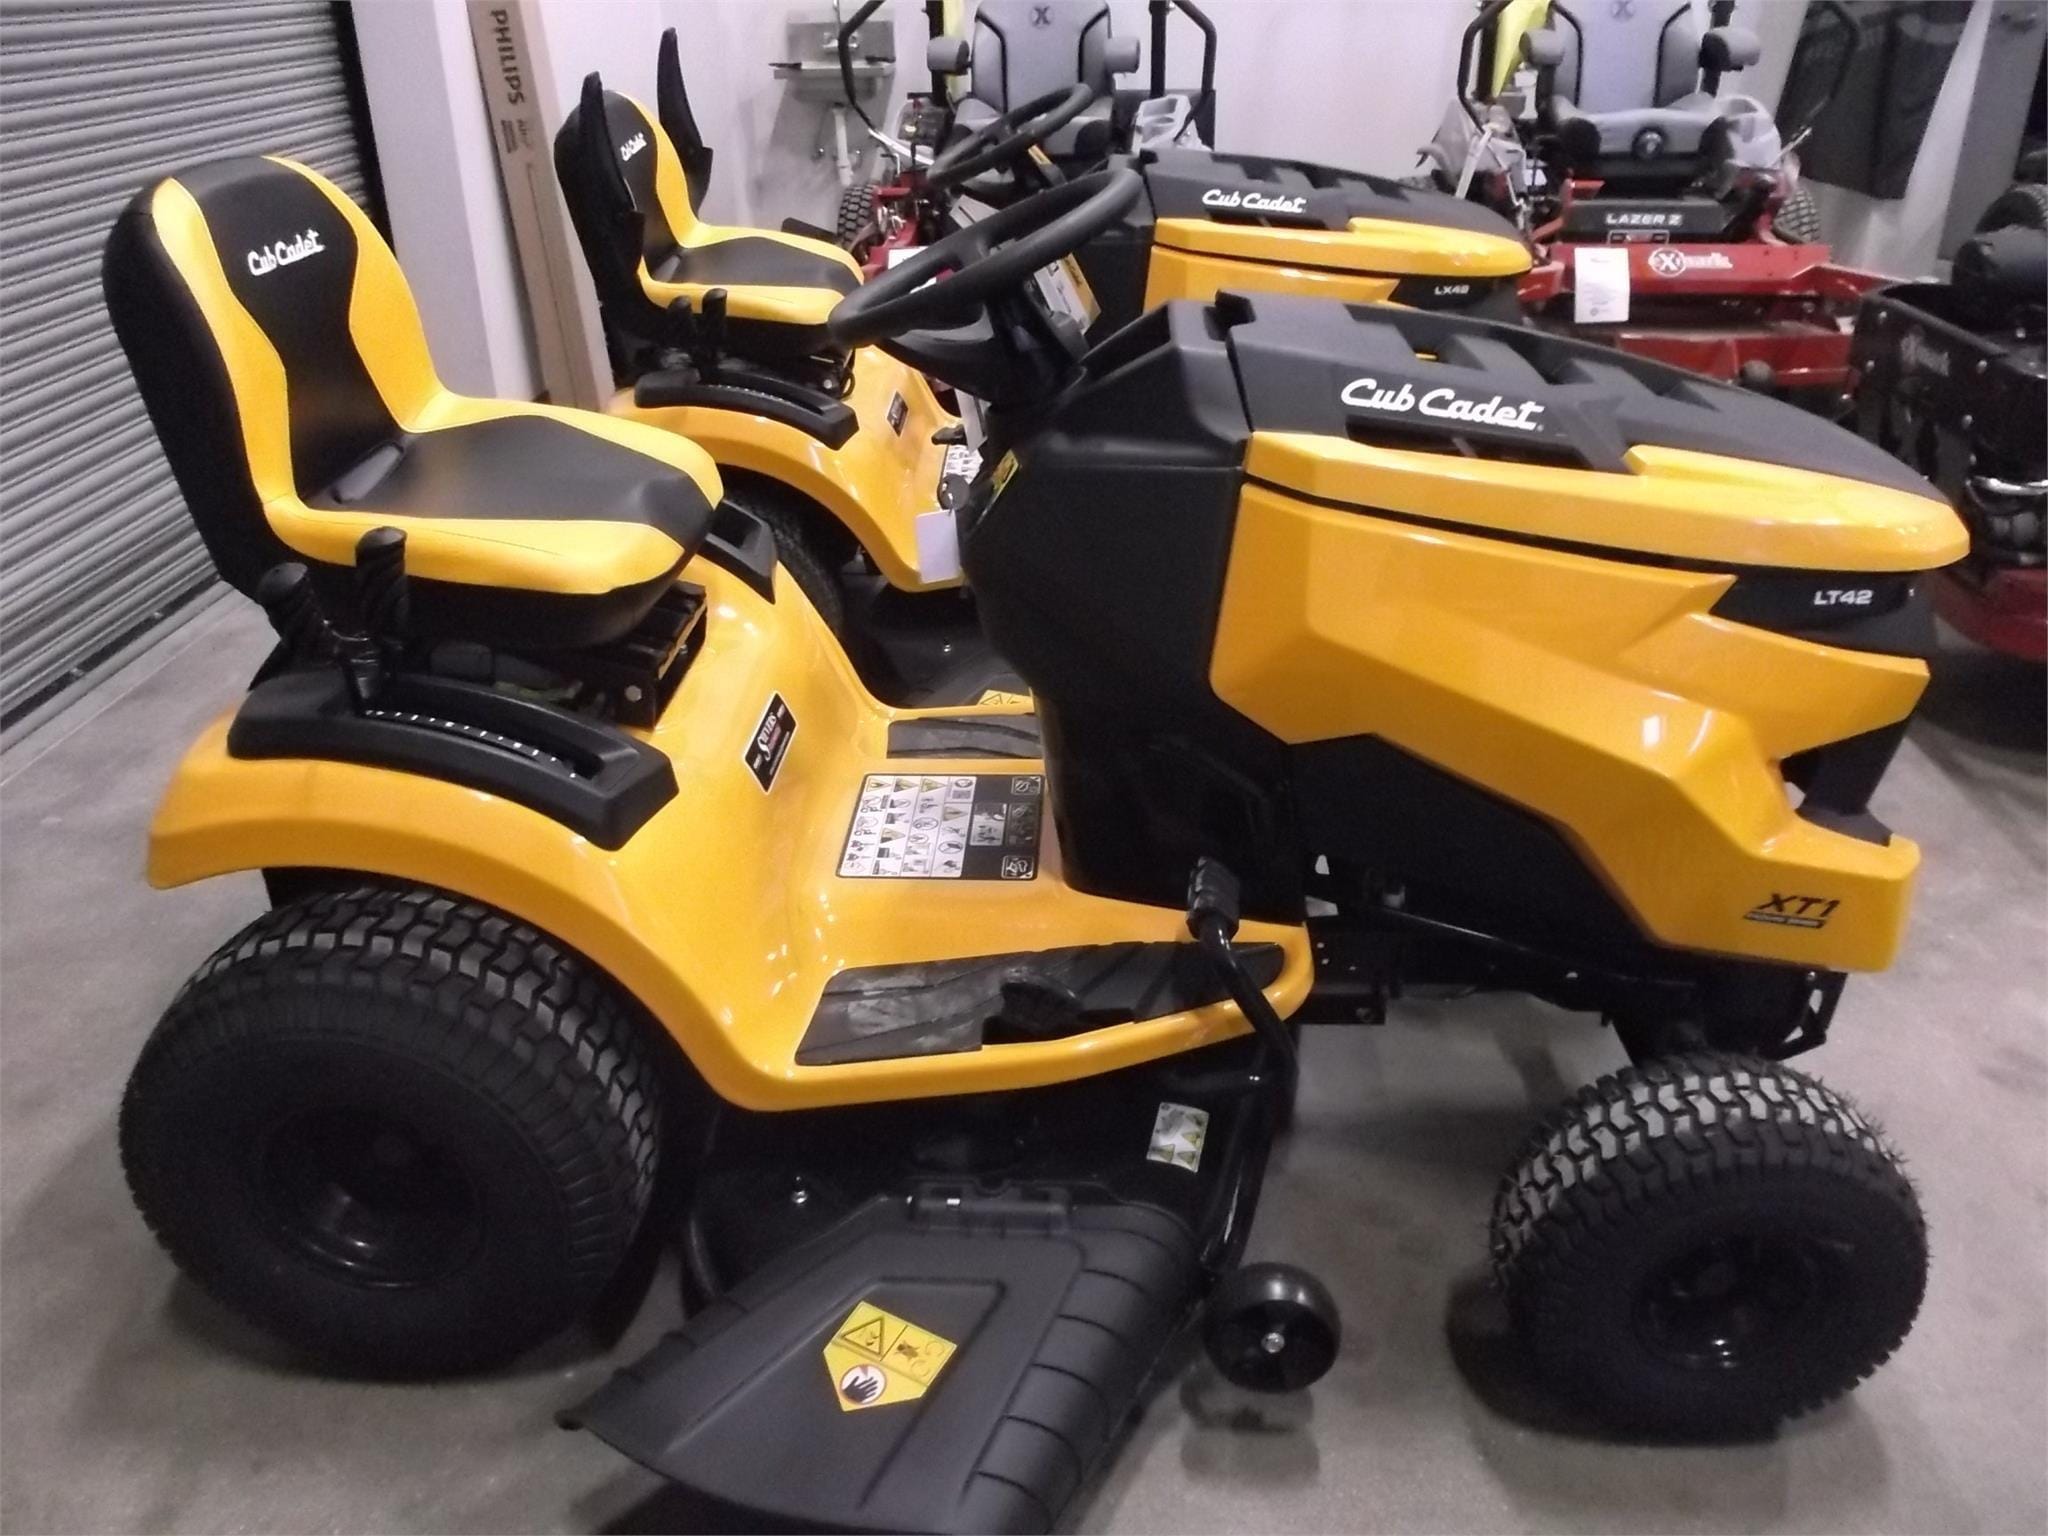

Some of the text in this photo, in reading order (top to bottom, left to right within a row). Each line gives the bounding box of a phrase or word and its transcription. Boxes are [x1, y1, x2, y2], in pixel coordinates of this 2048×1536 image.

[491, 9, 526, 106] PHILIPS
[1201, 189, 1307, 214] Cub Cadet
[1605, 213, 1683, 226] LAZER Z
[247, 228, 326, 276] Cub Cadet
[1340, 377, 1545, 431] Cub Cadet
[1813, 589, 1874, 606] LT42
[1754, 893, 1841, 918] XT1
